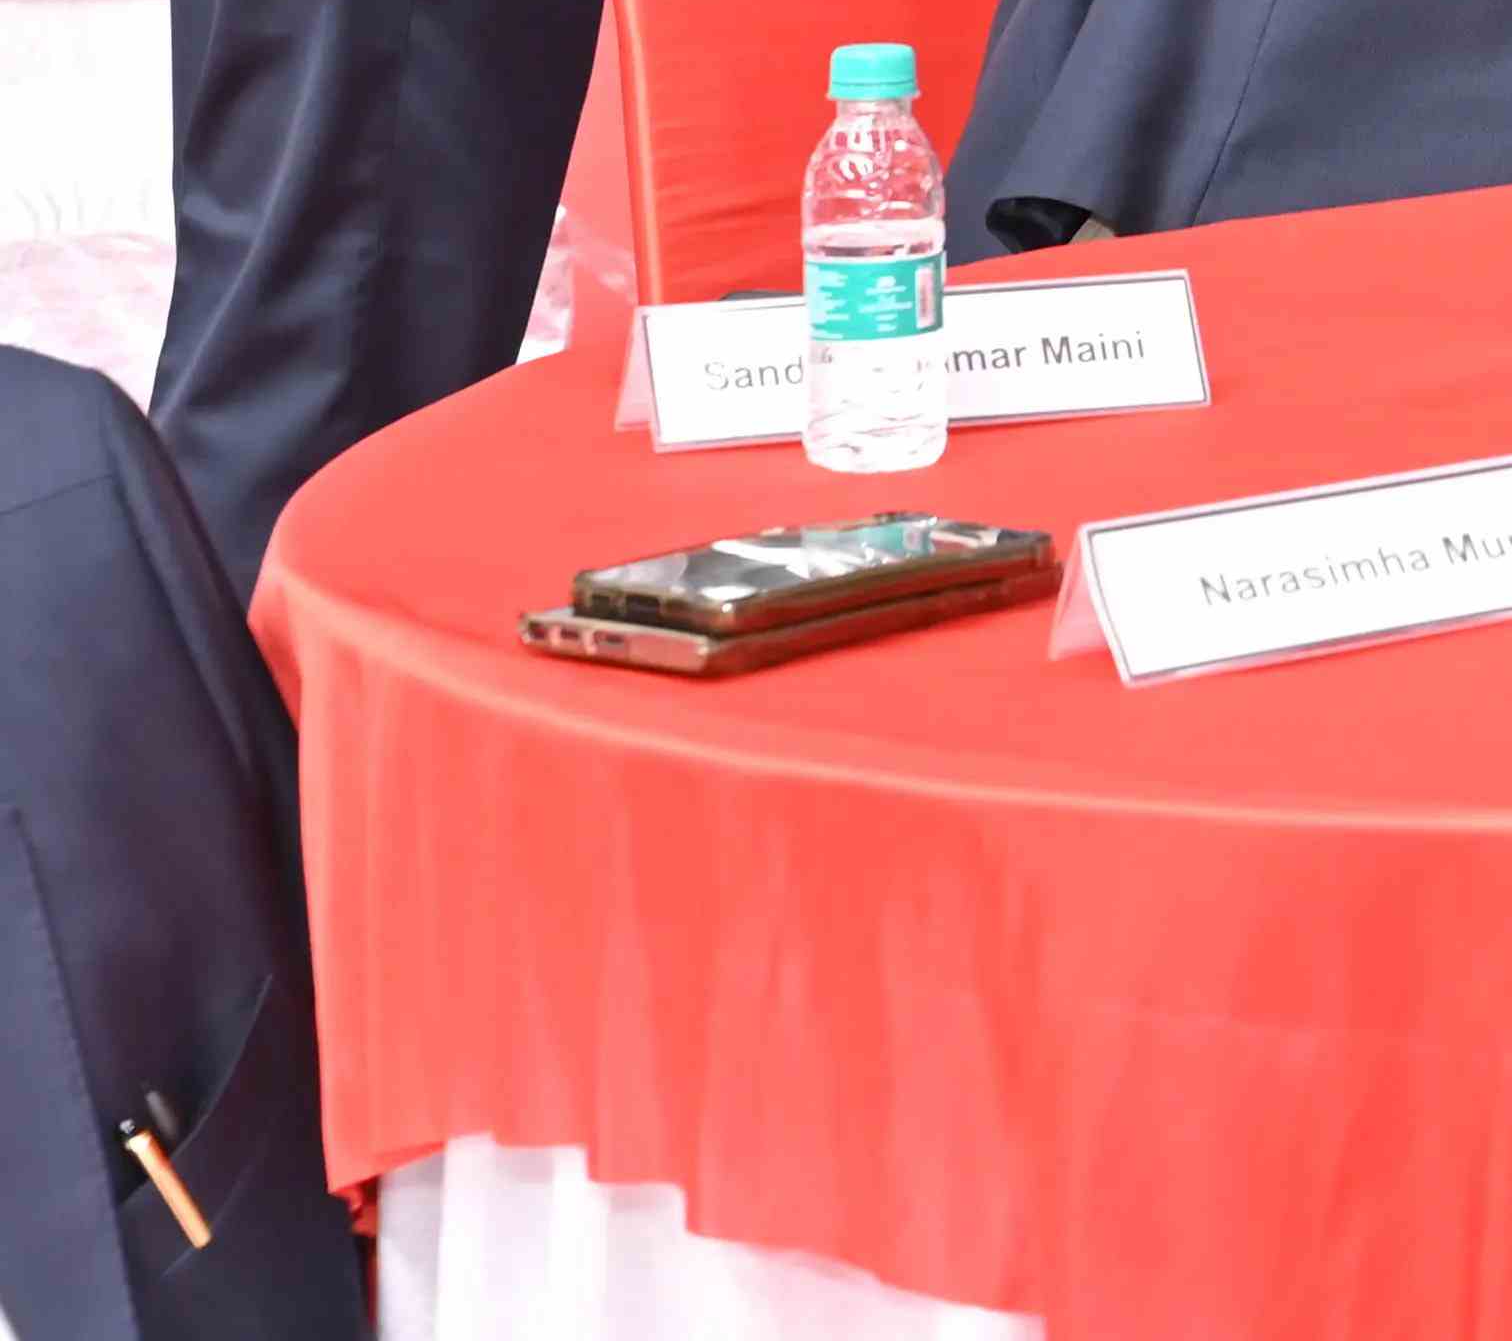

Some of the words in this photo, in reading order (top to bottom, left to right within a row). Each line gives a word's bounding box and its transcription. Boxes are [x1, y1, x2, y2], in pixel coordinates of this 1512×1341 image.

[703, 354, 804, 392] Sand
[944, 346, 1027, 374] mar
[1041, 330, 1145, 366] Maini
[1200, 546, 1430, 607] Narasimha
